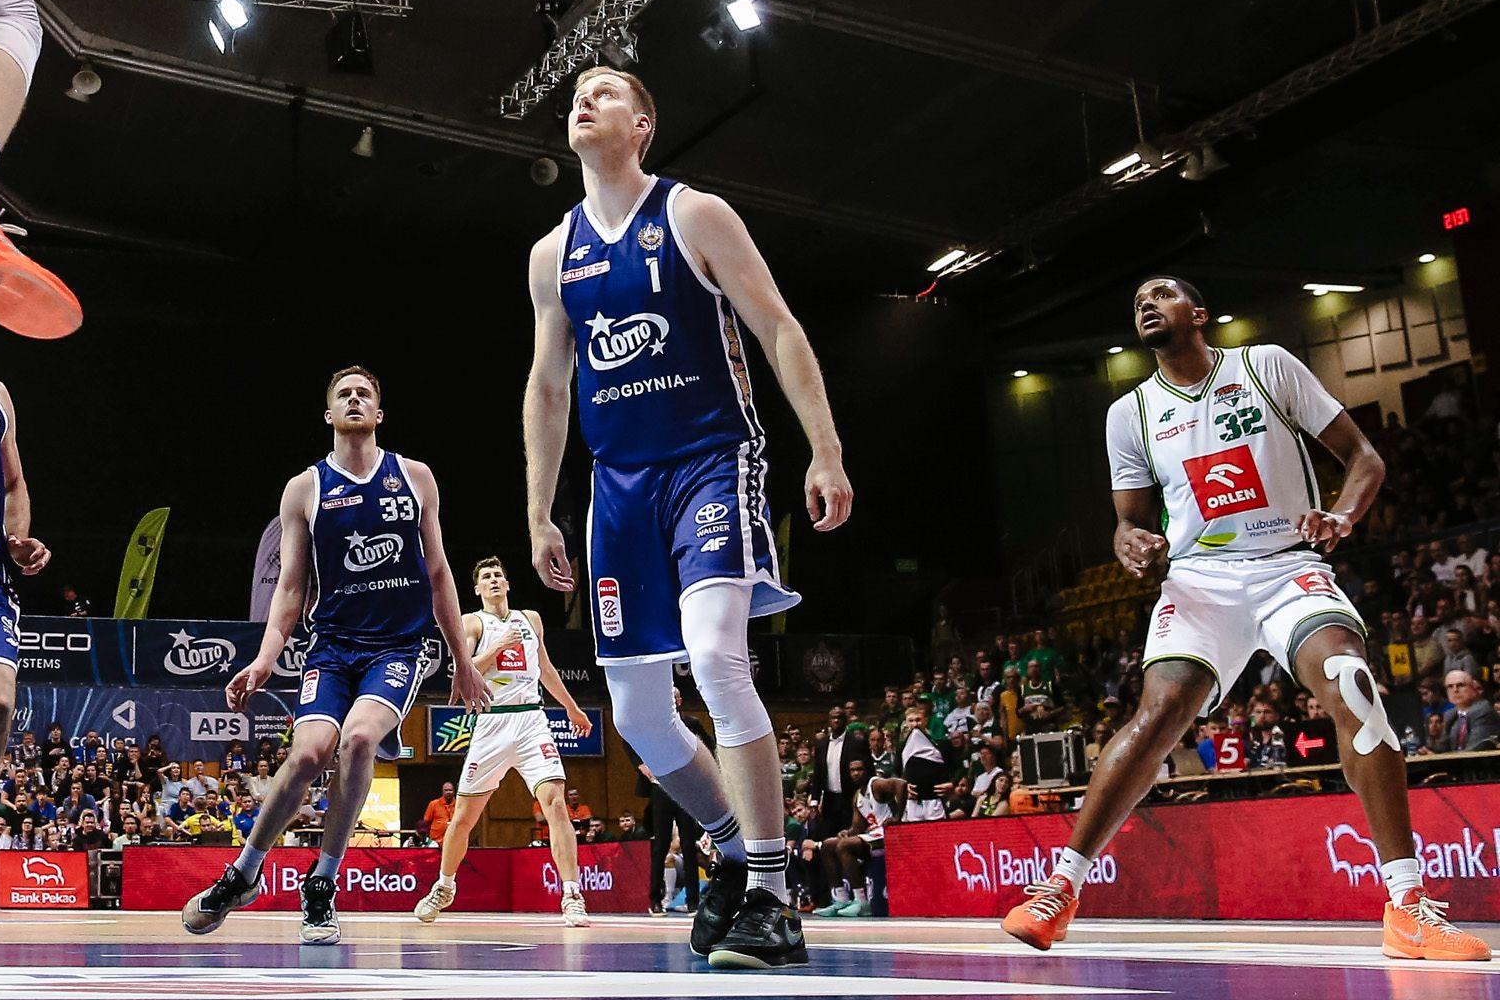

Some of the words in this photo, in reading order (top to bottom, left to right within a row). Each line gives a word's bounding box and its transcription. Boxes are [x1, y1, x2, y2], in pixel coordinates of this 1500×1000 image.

[569, 244, 591, 261] 4F
[563, 269, 585, 281] ORLEN
[645, 257, 661, 293] 1
[598, 321, 651, 360] LOTTO
[621, 374, 685, 398] GDYNIA
[1159, 408, 1176, 423] 4F
[1215, 406, 1267, 442] 32
[327, 485, 345, 496] 4F
[1207, 488, 1257, 509] ORLEN
[379, 496, 414, 522] 33
[696, 524, 730, 538] WALDER
[354, 539, 394, 565] LOTTO
[700, 536, 728, 553] 4F
[368, 577, 410, 591] GDYNIA
[18, 658, 61, 669] YSTEMS
[179, 646, 223, 668] LOTTO
[501, 660, 524, 668] ORLEN
[560, 669, 590, 681] NNA
[197, 718, 241, 735] APS
[255, 723, 288, 731] protectio
[549, 719, 567, 728] sat
[1219, 738, 1239, 765] 5
[999, 850, 1048, 886] Bank
[281, 867, 339, 892] Bak
[346, 867, 416, 892] Pekao
[584, 865, 613, 891] Pekao
[11, 892, 40, 904] Bank
[42, 892, 76, 904] Pekao
